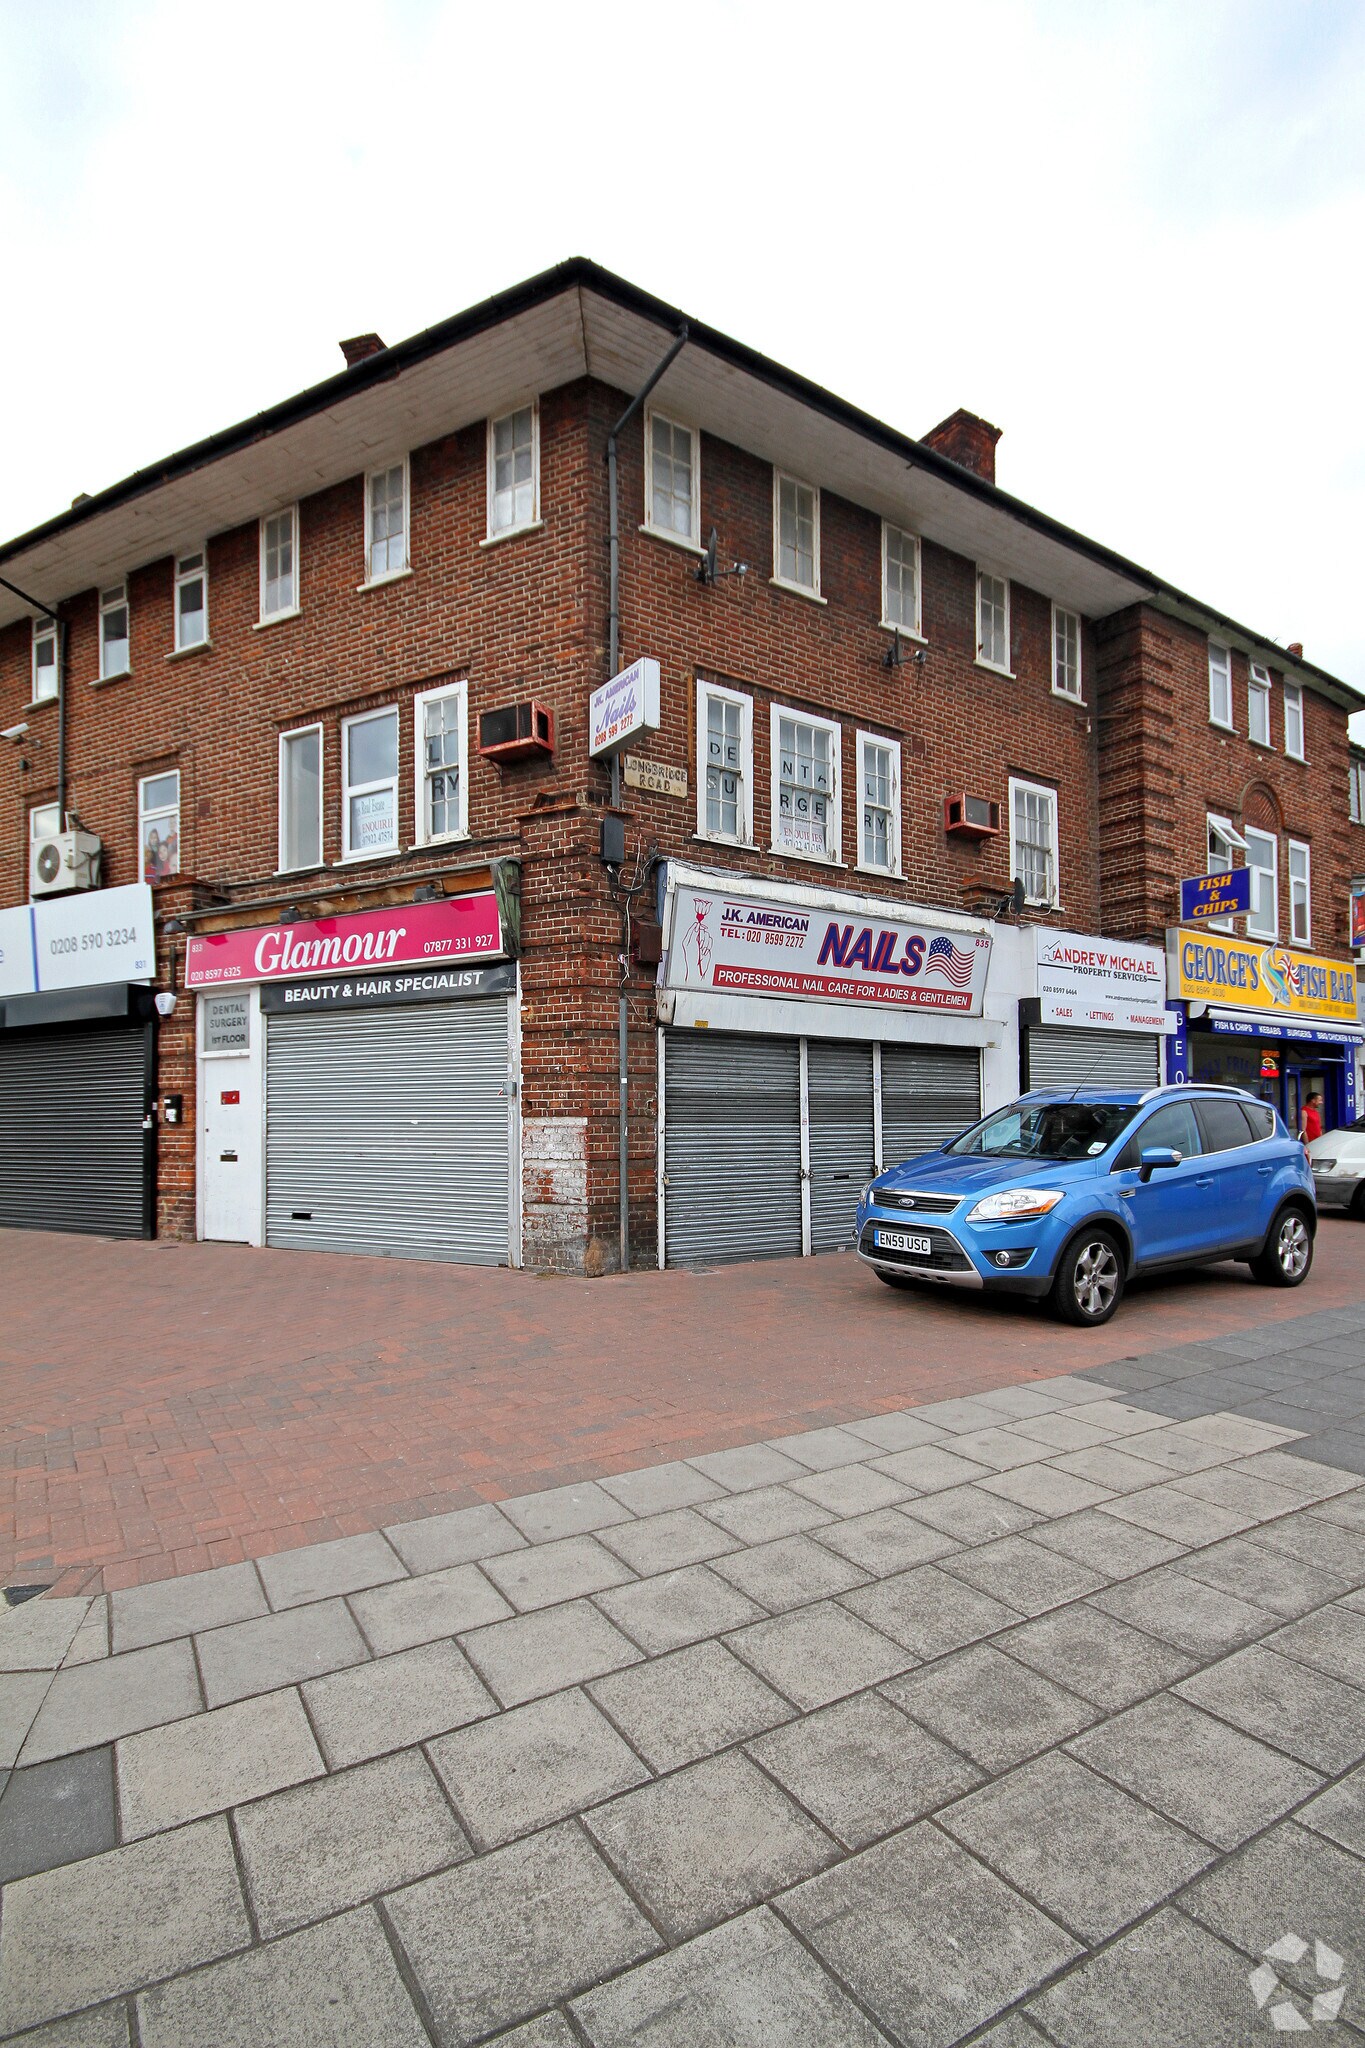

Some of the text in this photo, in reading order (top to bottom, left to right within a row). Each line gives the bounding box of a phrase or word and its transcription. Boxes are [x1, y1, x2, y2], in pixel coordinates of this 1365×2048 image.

[605, 668, 639, 700] AMERICAN
[596, 687, 636, 733] Nails
[621, 713, 633, 731] 2272
[625, 757, 687, 782] LONGBRIDGE
[639, 773, 671, 791] ROAD
[1198, 874, 1233, 892] FISH
[1209, 890, 1221, 901] &
[1193, 898, 1238, 917] CHIPS
[722, 908, 809, 931] J.K. AMERICAN
[50, 927, 137, 955] 0208 590 3234
[254, 926, 406, 973] Glamour
[424, 934, 494, 954] 07877 331 927
[765, 932, 784, 946] 8599
[785, 935, 804, 949] 2272
[817, 922, 927, 976] NAILS
[975, 938, 990, 949] 835
[1053, 948, 1158, 975] ANDREW MICHAEL
[190, 966, 241, 981] 020 8597 6325
[1073, 965, 1148, 983] PROPERTY SERVICES
[1183, 942, 1355, 1004] GEORGE'S FISH BAR
[285, 971, 484, 1002] BEAUTY & HAIR SPECIALIST
[718, 970, 968, 1006] PROFESSIONAL NAIL CARE FOR LADIES & GENTLEMEN
[1043, 985, 1052, 993] 020
[1053, 986, 1065, 994] 8597
[212, 1003, 245, 1015] DENTAL
[1055, 1007, 1166, 1026] SALES LETTINGS MANAGEMENT
[210, 1016, 247, 1028] SURGERY
[1214, 1021, 1229, 1030] FISH
[1229, 1022, 1235, 1031] &
[1235, 1023, 1253, 1032] CHIPS
[1258, 1025, 1282, 1035] KEBABS
[1286, 1029, 1313, 1039] BURGERS
[222, 1033, 246, 1044] FLOOR
[879, 1233, 928, 1251] EN59 USC
